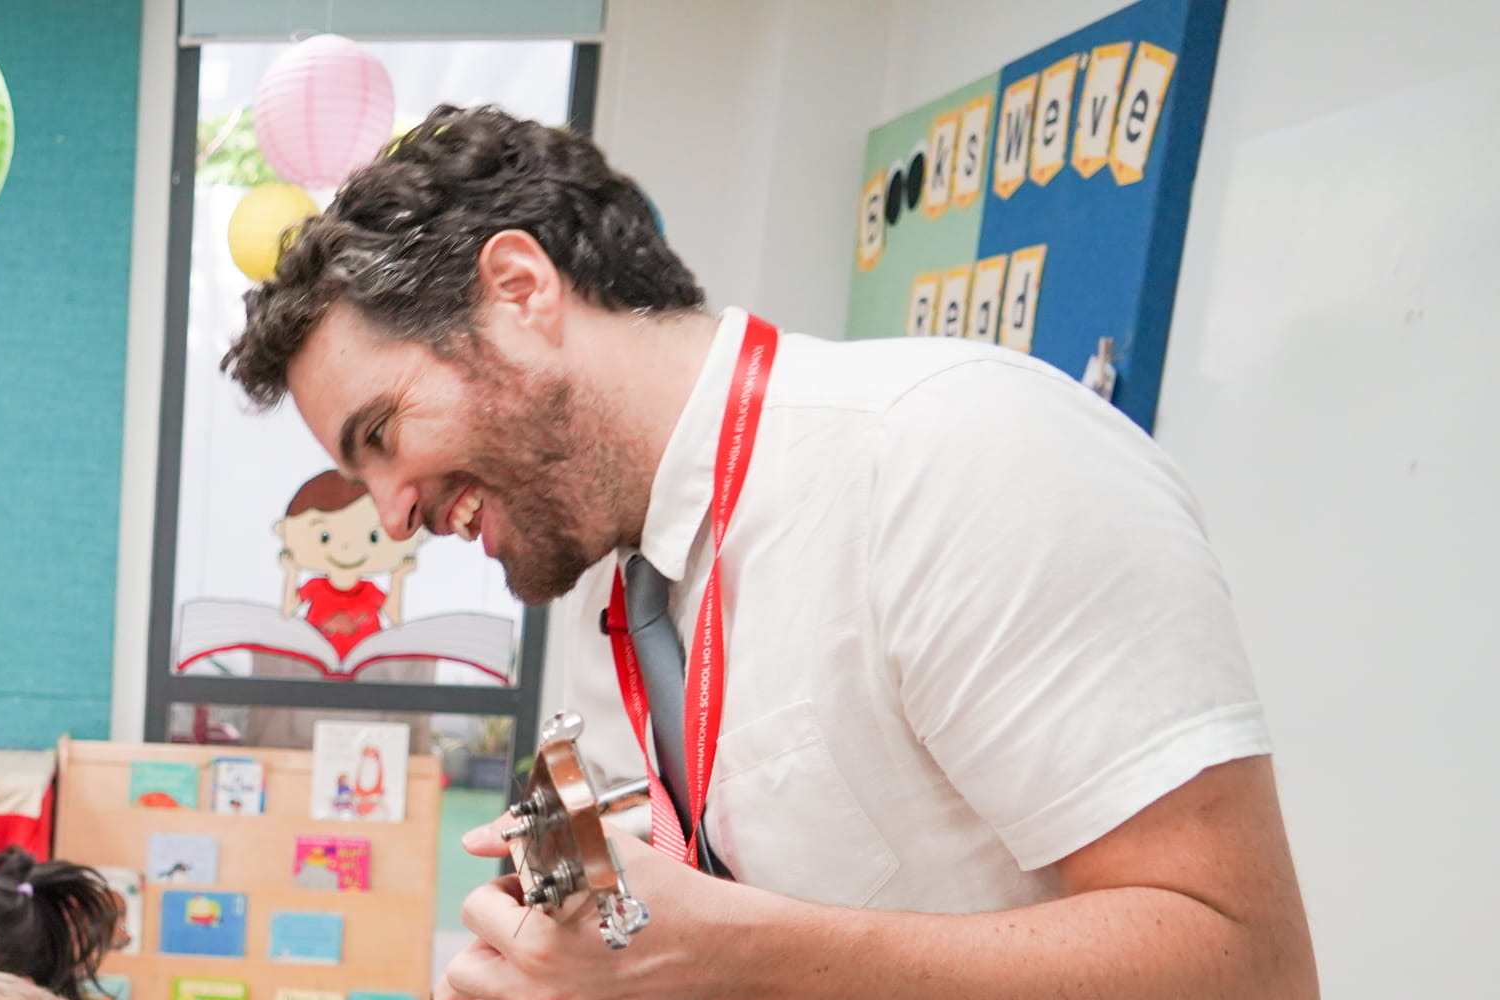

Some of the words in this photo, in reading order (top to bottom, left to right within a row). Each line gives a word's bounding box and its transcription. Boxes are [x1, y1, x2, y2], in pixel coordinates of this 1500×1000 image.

[703, 628, 712, 647] CHI
[702, 647, 712, 665] HO
[699, 664, 711, 708] SCHOOL
[696, 709, 709, 792] INTERNATIONAL
